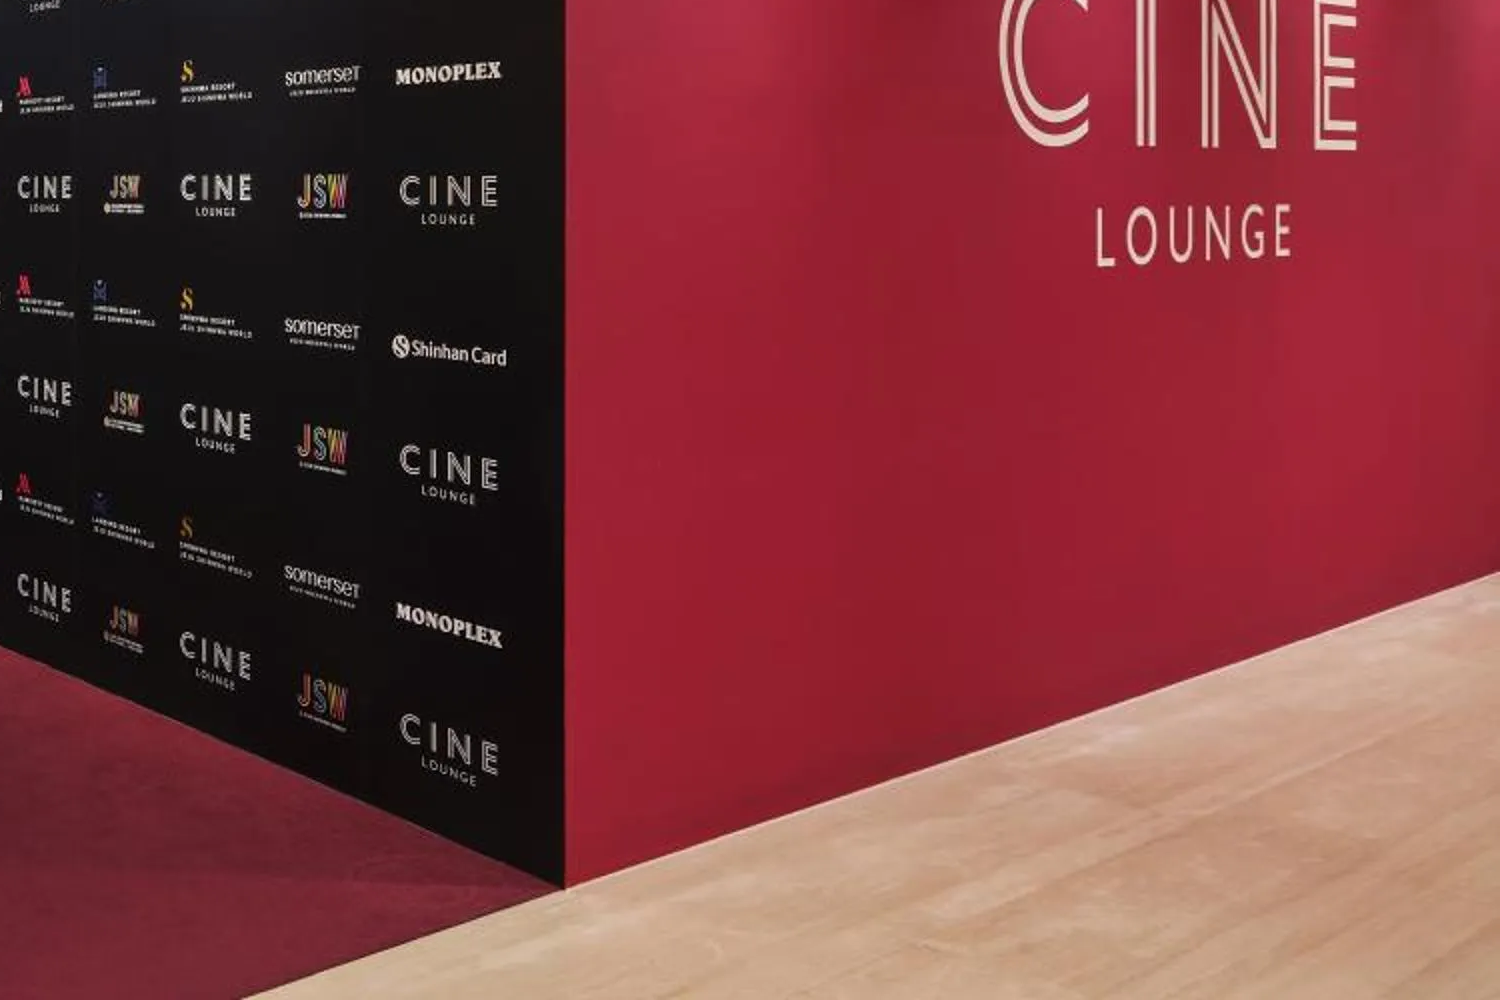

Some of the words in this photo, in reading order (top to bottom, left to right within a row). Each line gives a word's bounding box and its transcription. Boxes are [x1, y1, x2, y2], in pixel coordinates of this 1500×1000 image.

[396, 61, 501, 85] MONOPLEX
[17, 175, 71, 199] CINE
[180, 174, 251, 201] CINE
[296, 174, 348, 209] JSW
[399, 175, 497, 207] CINE
[195, 206, 235, 217] LOUNGE
[421, 213, 475, 225] LOUNGE
[1095, 203, 1292, 268] LOUNGE
[411, 339, 468, 362] Shinhan
[471, 346, 506, 366] Card
[17, 373, 71, 406] CINE
[180, 402, 250, 441] CINE
[195, 436, 234, 454] LOUNGE
[297, 422, 348, 466] JSW
[399, 442, 498, 492] CINE
[421, 483, 475, 506] LOUNGE
[17, 571, 70, 614] CINE
[396, 602, 502, 649] MONOPLEX
[179, 628, 250, 681] CINE
[195, 666, 234, 692] LOUNGE
[297, 670, 348, 724] JSW
[400, 710, 498, 776] CINE
[421, 755, 476, 788] LOUNGE
